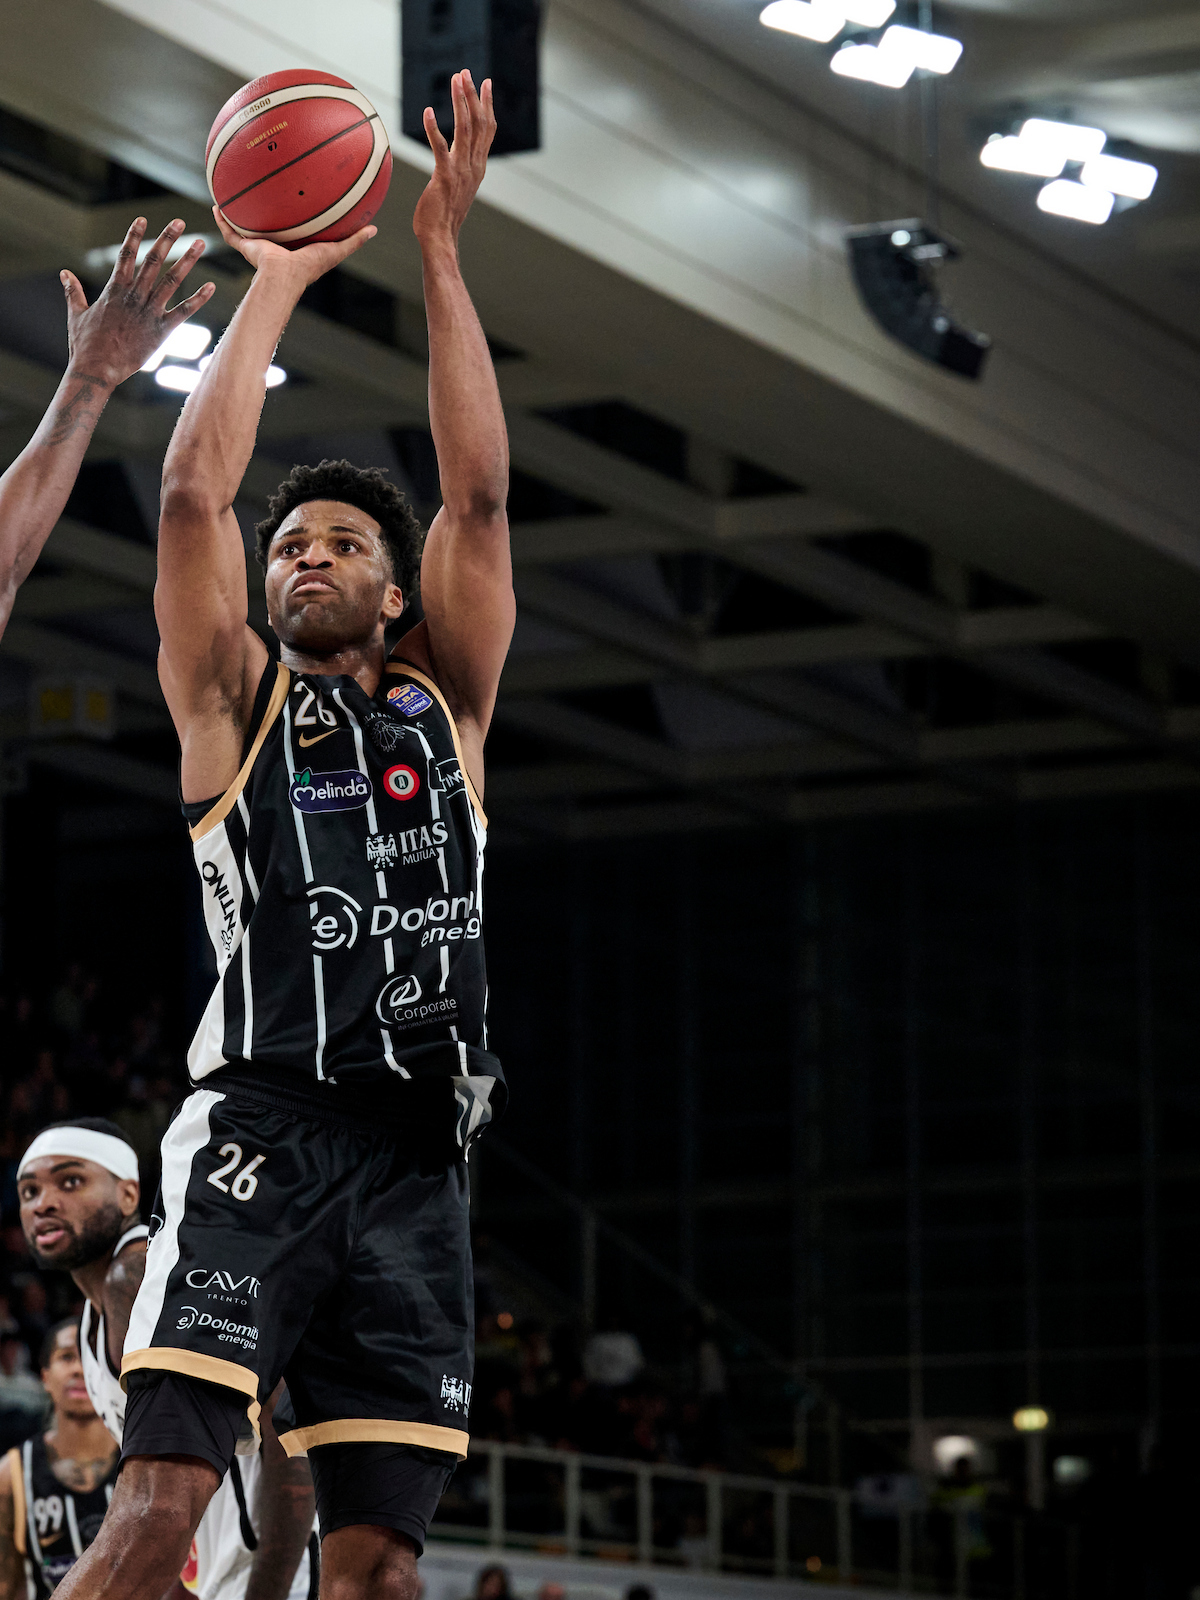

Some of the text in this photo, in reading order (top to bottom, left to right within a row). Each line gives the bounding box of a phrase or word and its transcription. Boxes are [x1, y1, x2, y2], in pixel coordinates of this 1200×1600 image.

[294, 681, 338, 727] 26
[396, 691, 420, 708] LBA
[293, 779, 368, 802] Melinda
[399, 821, 449, 854] ITAS
[402, 848, 437, 866] MUTUA
[394, 998, 457, 1021] Corporate
[207, 1142, 267, 1201] 26
[207, 1293, 248, 1306] TRENTO
[218, 1333, 257, 1350] energia
[34, 1494, 64, 1535] 99
